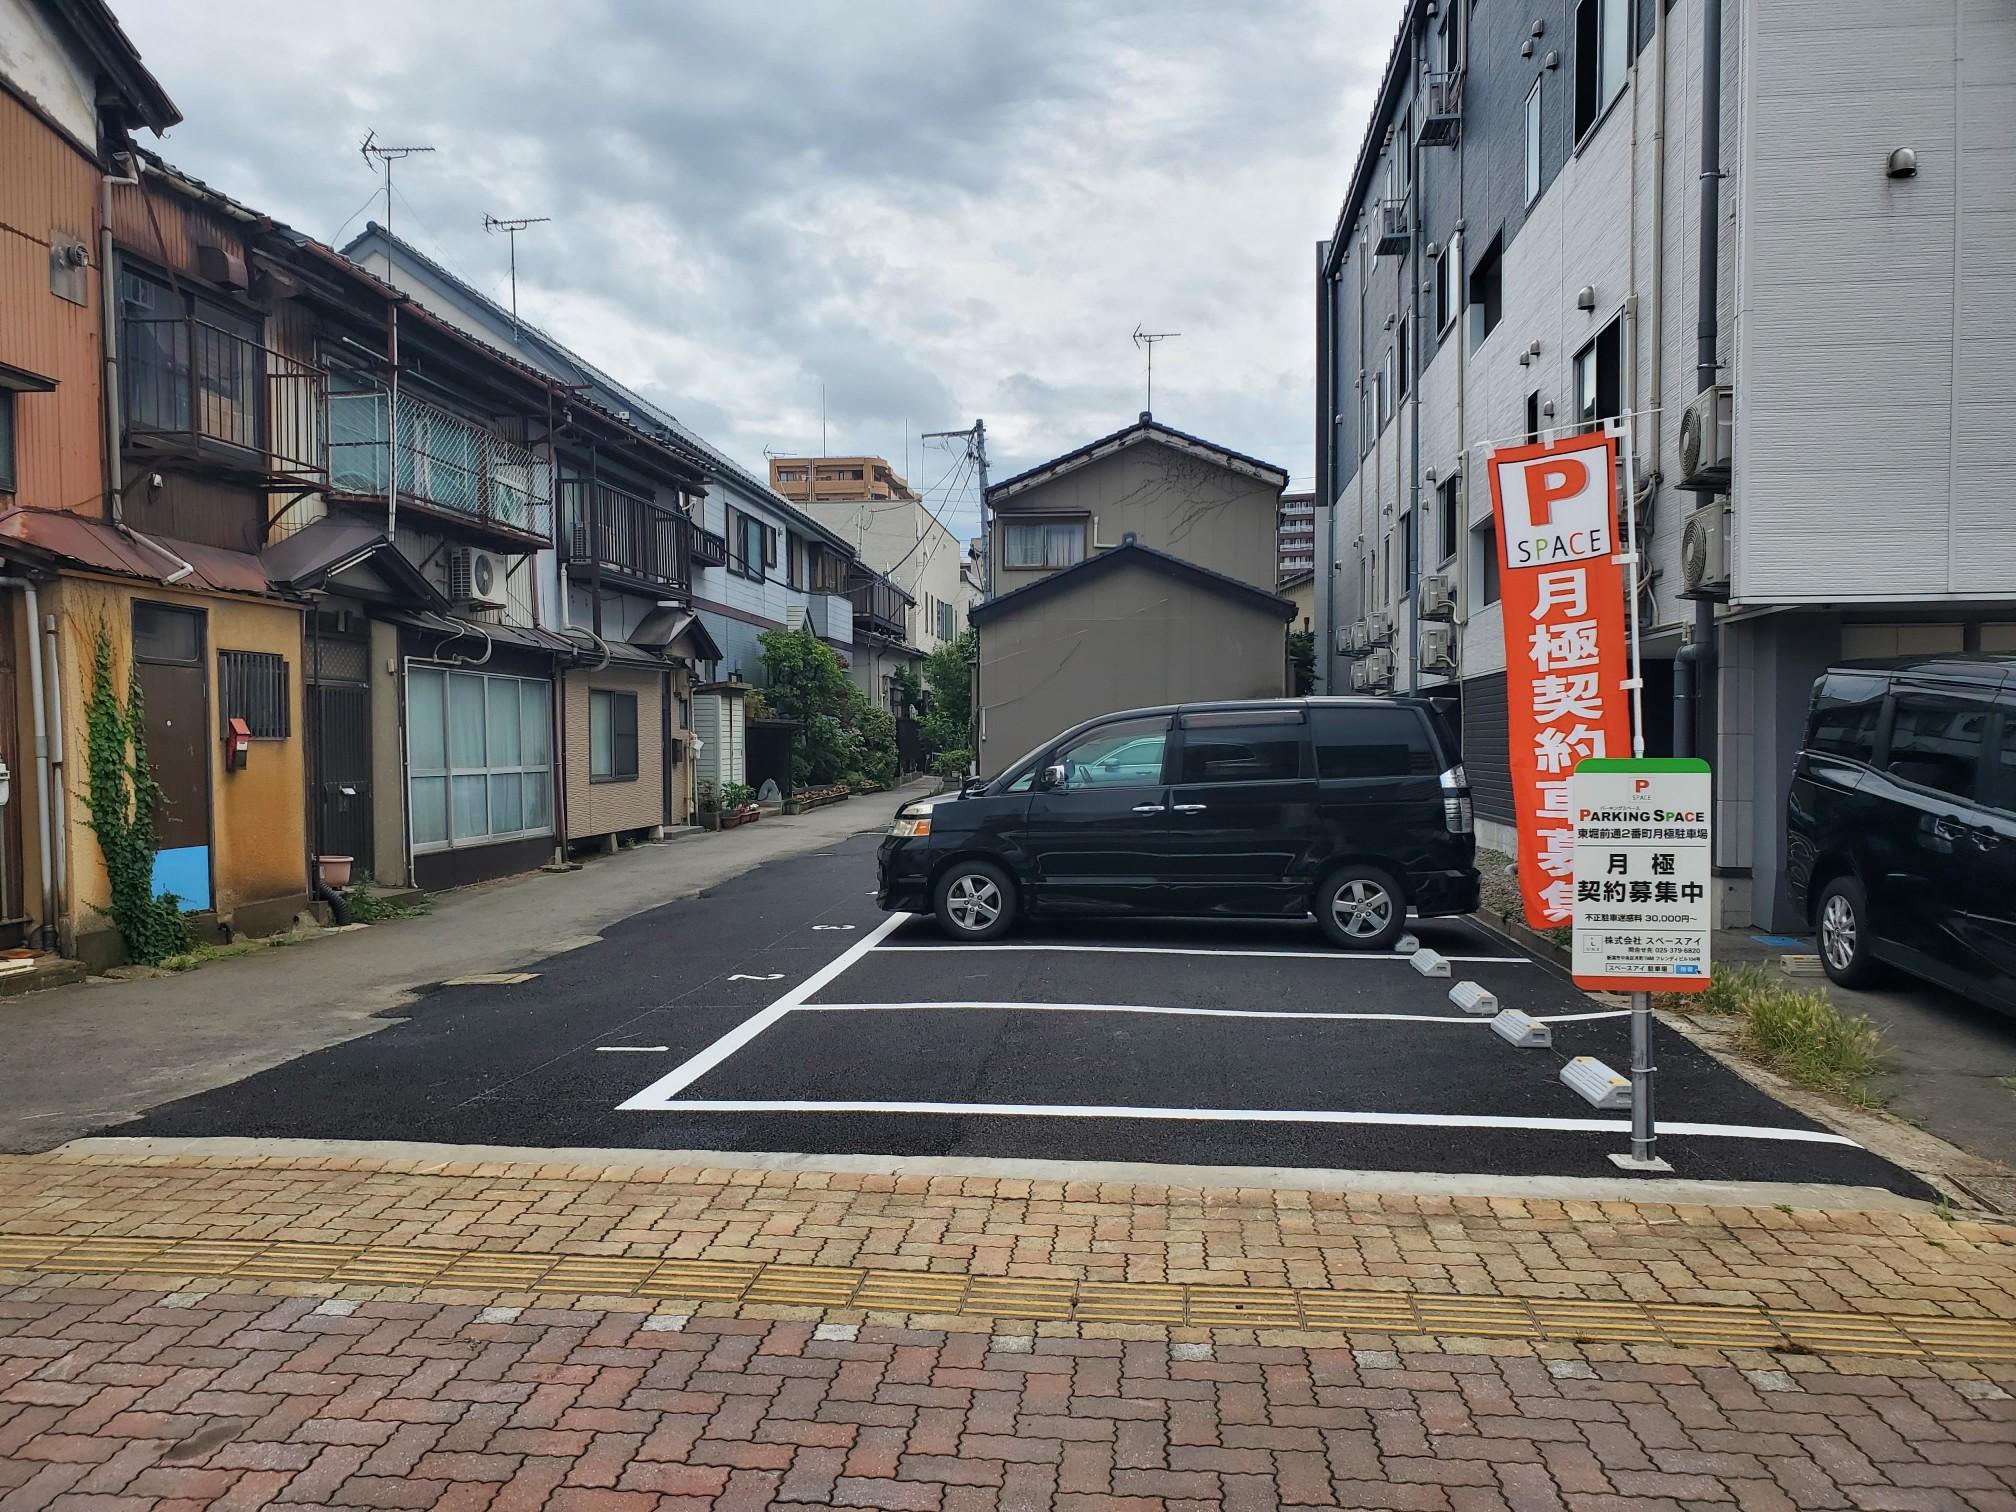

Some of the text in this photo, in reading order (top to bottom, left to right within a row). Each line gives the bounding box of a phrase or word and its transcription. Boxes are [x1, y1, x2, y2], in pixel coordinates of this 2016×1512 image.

[1524, 458, 1590, 527] P
[1517, 529, 1601, 563] SPACE
[1635, 779, 1650, 793] P
[1579, 809, 1705, 822] PARKING SPACE
[1577, 880, 1704, 904] 契約募集中
